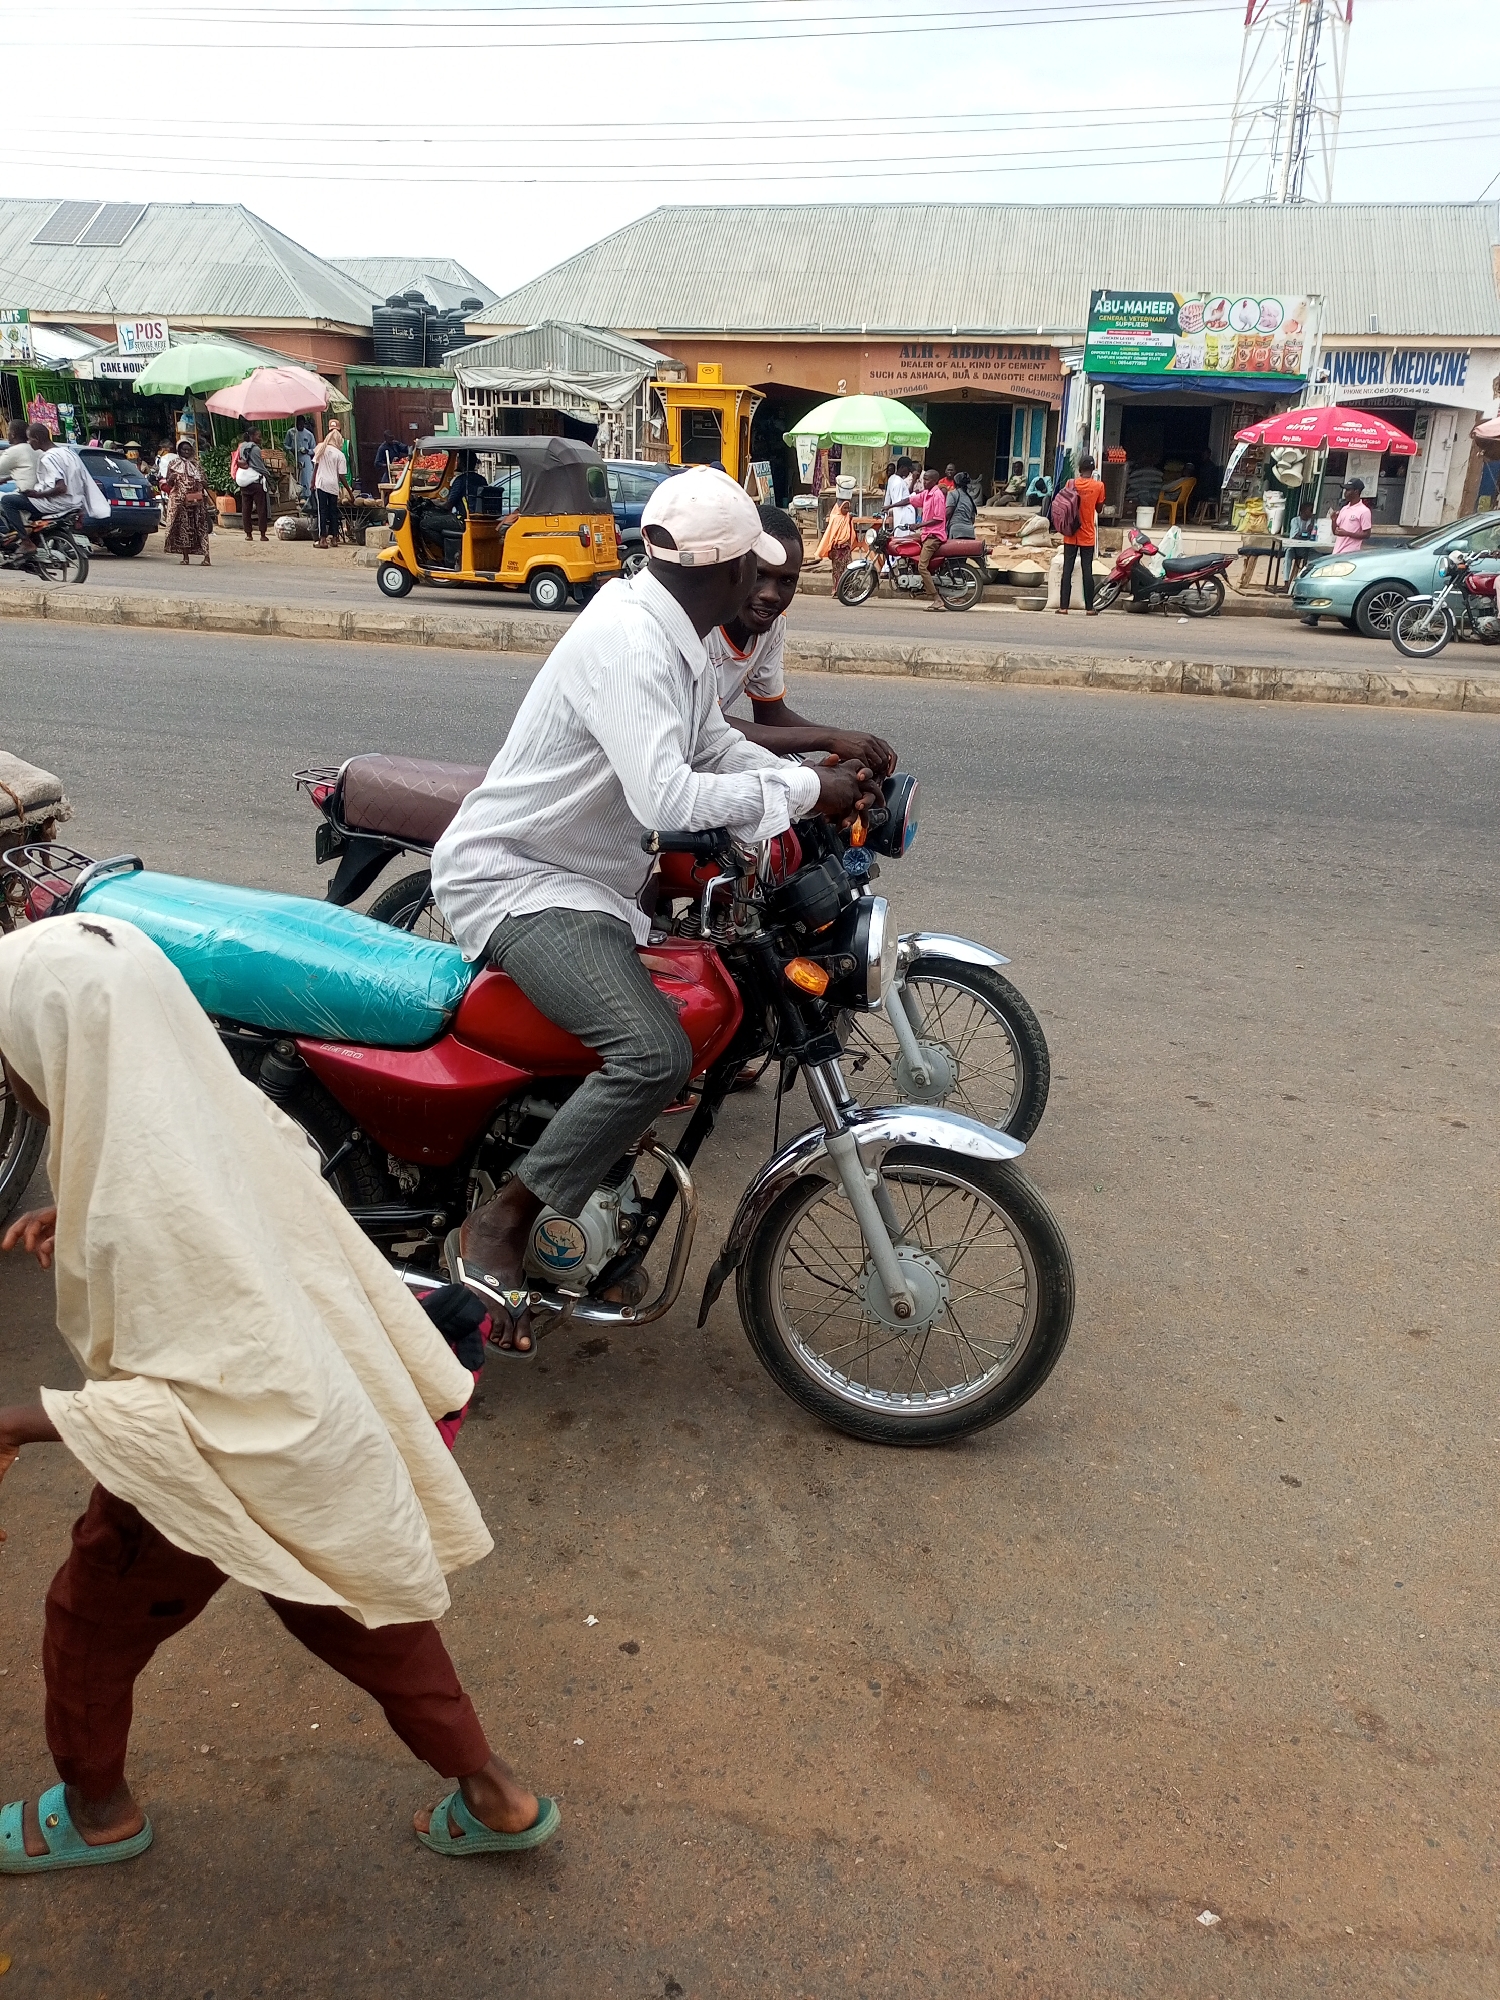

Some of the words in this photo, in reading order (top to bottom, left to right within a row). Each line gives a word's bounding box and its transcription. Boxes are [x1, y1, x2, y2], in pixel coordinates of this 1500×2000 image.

[1093, 299, 1175, 315] ABU-MAHEER
[135, 322, 163, 340] POS
[947, 344, 1050, 360] ABDULLAHI
[100, 361, 122, 373] CAKE
[122, 361, 148, 374] HOUS
[969, 361, 991, 369] KIND
[1008, 362, 1046, 370] CEMENT
[1390, 351, 1471, 387] MEDICINE
[869, 371, 894, 379] SUCH
[896, 371, 908, 379] AS
[972, 372, 979, 380] &
[982, 372, 1025, 381] DANGOTE
[1028, 373, 1065, 382] CEMENT
[1285, 423, 1316, 431] airtel
[1336, 435, 1350, 443] Open
